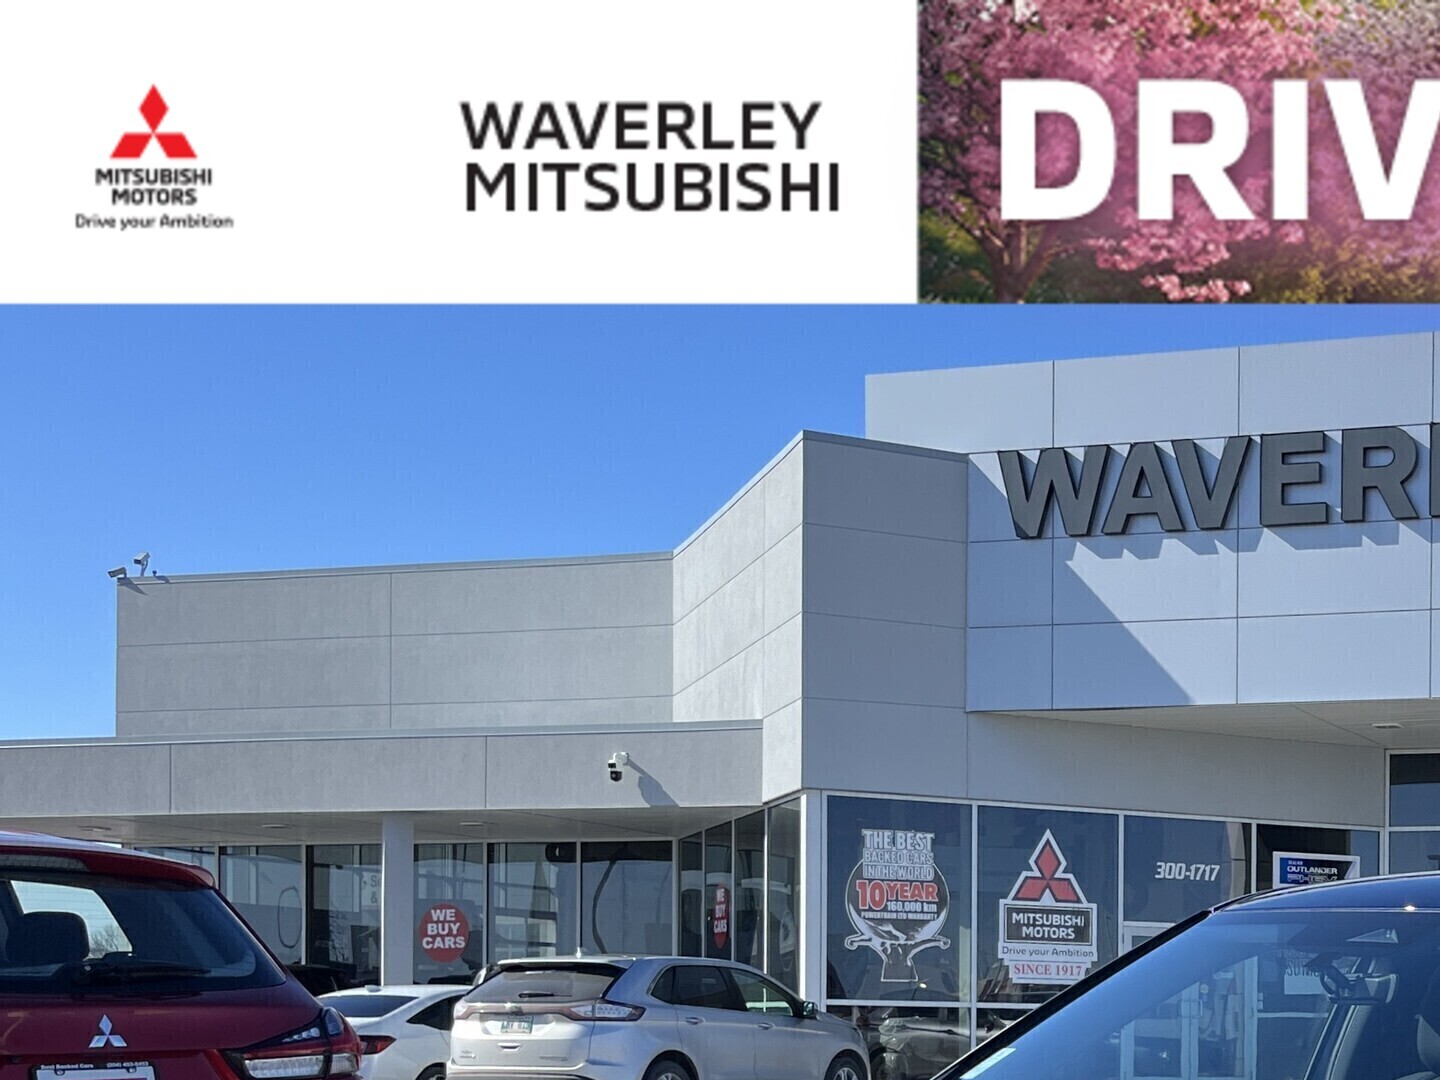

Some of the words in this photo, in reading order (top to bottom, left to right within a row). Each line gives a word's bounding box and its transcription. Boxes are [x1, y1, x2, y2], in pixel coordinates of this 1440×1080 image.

[863, 830, 892, 849] THE
[896, 832, 934, 852] BEST
[865, 850, 904, 864] BACKED
[906, 852, 934, 865] CARS
[897, 866, 933, 879] WORLD
[1154, 862, 1220, 881] 300-1717
[1287, 865, 1338, 875] OUTLANDER
[856, 880, 886, 910] 10
[884, 882, 938, 901] YEAR
[886, 901, 922, 912] 160,000
[923, 903, 937, 912] km
[431, 909, 456, 921] WE
[1012, 912, 1085, 926] MITSUBISHI
[427, 923, 460, 935] BUY
[1022, 926, 1075, 939] MOTORS
[422, 936, 466, 949] CARS
[1002, 946, 1026, 955] Drive
[1028, 949, 1050, 957] your
[1051, 948, 1094, 957] Ambition
[1013, 963, 1052, 975] SINCE
[1056, 965, 1082, 976] 1917
